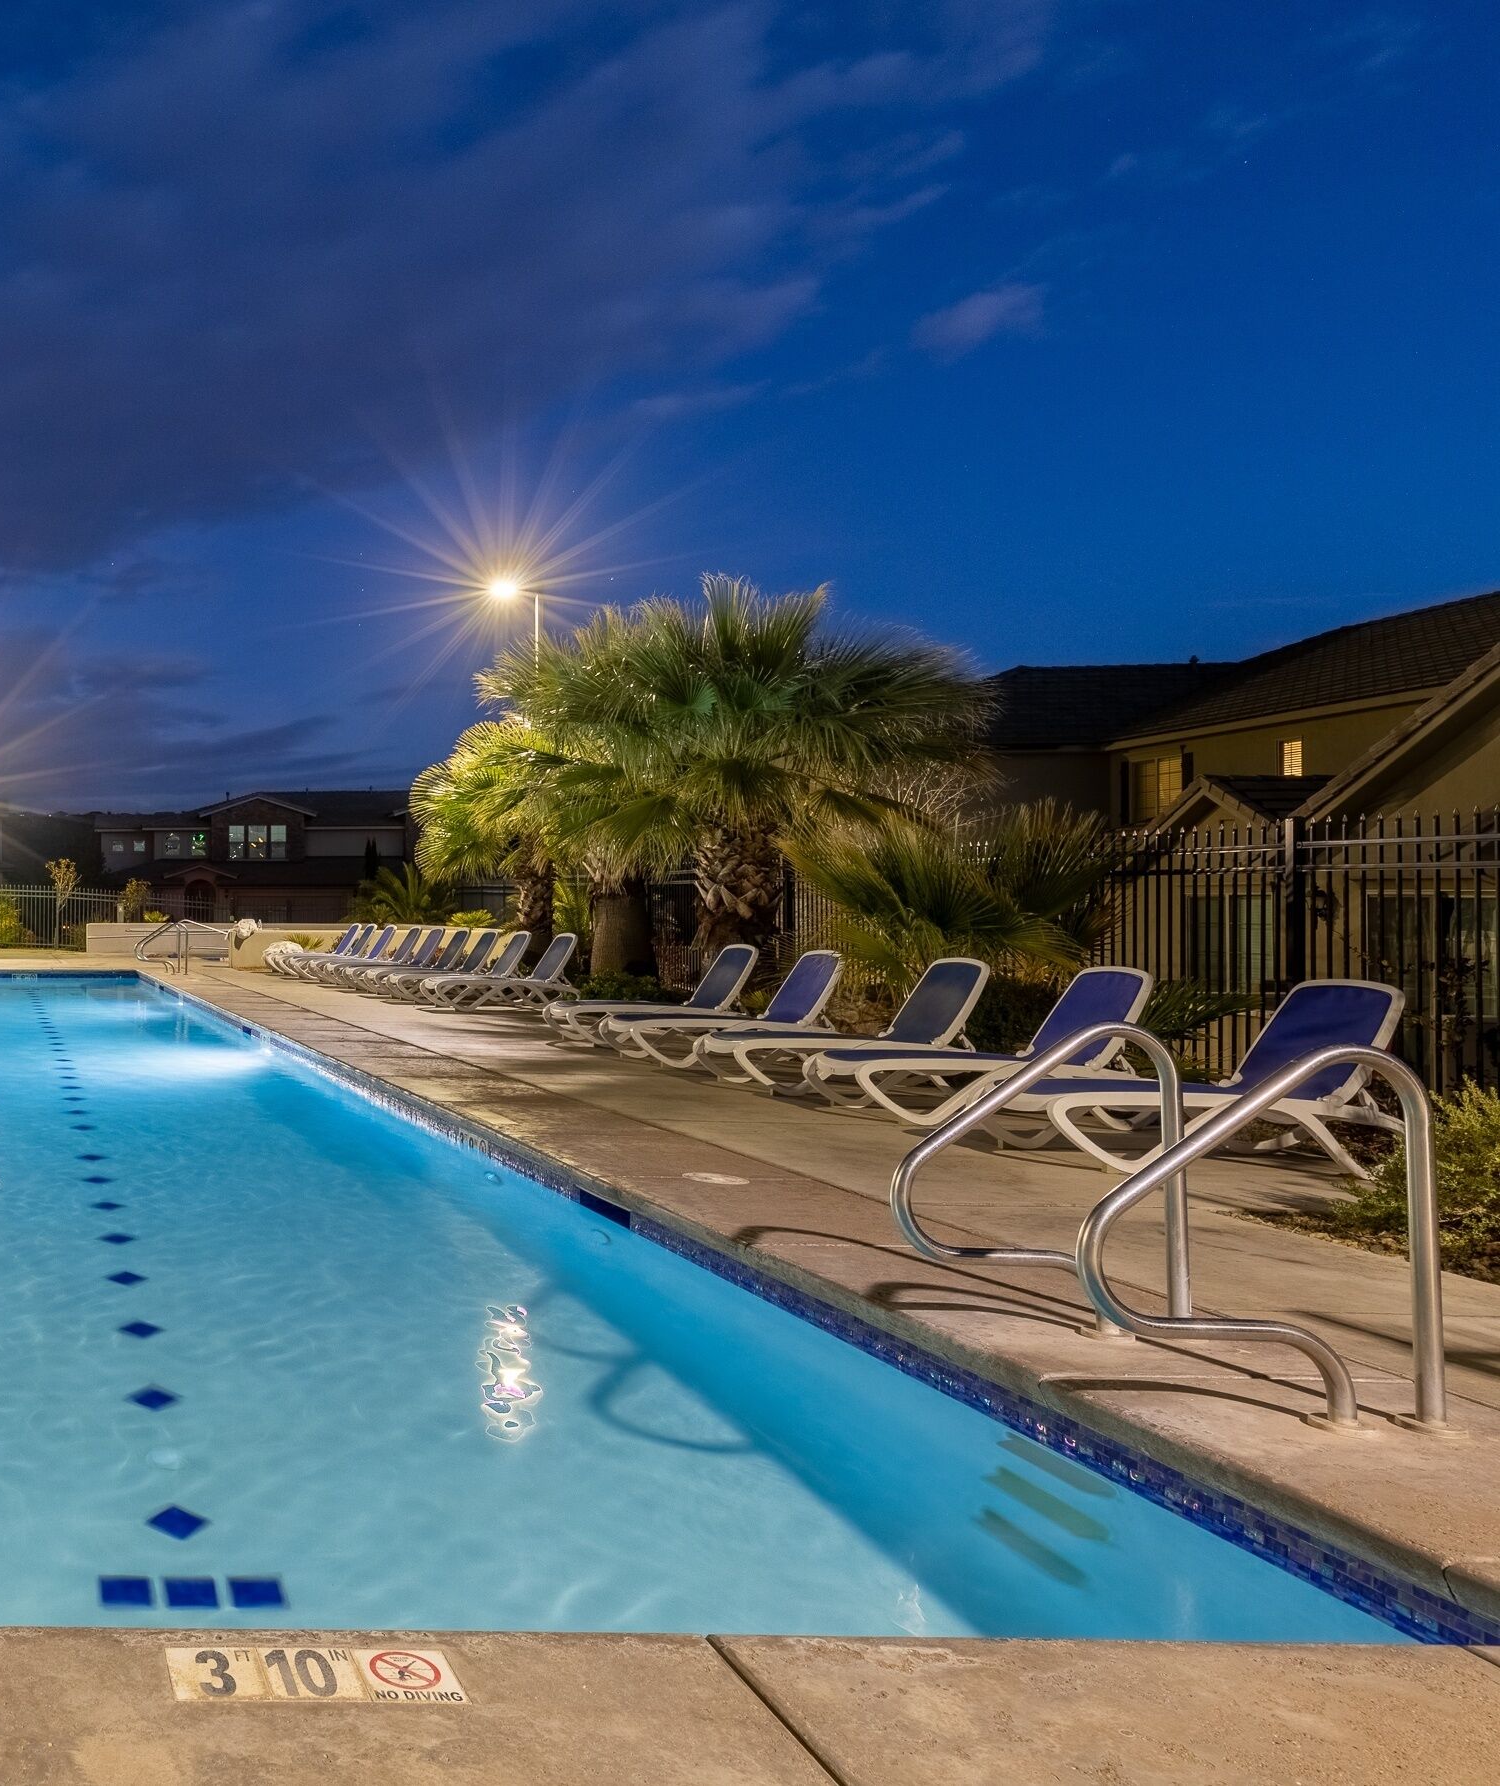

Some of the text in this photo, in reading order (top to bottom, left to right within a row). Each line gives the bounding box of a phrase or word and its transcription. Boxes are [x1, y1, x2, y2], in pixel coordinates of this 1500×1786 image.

[195, 1649, 349, 1697] 3 FT 10 IN
[374, 1690, 464, 1702] NO DIVING
